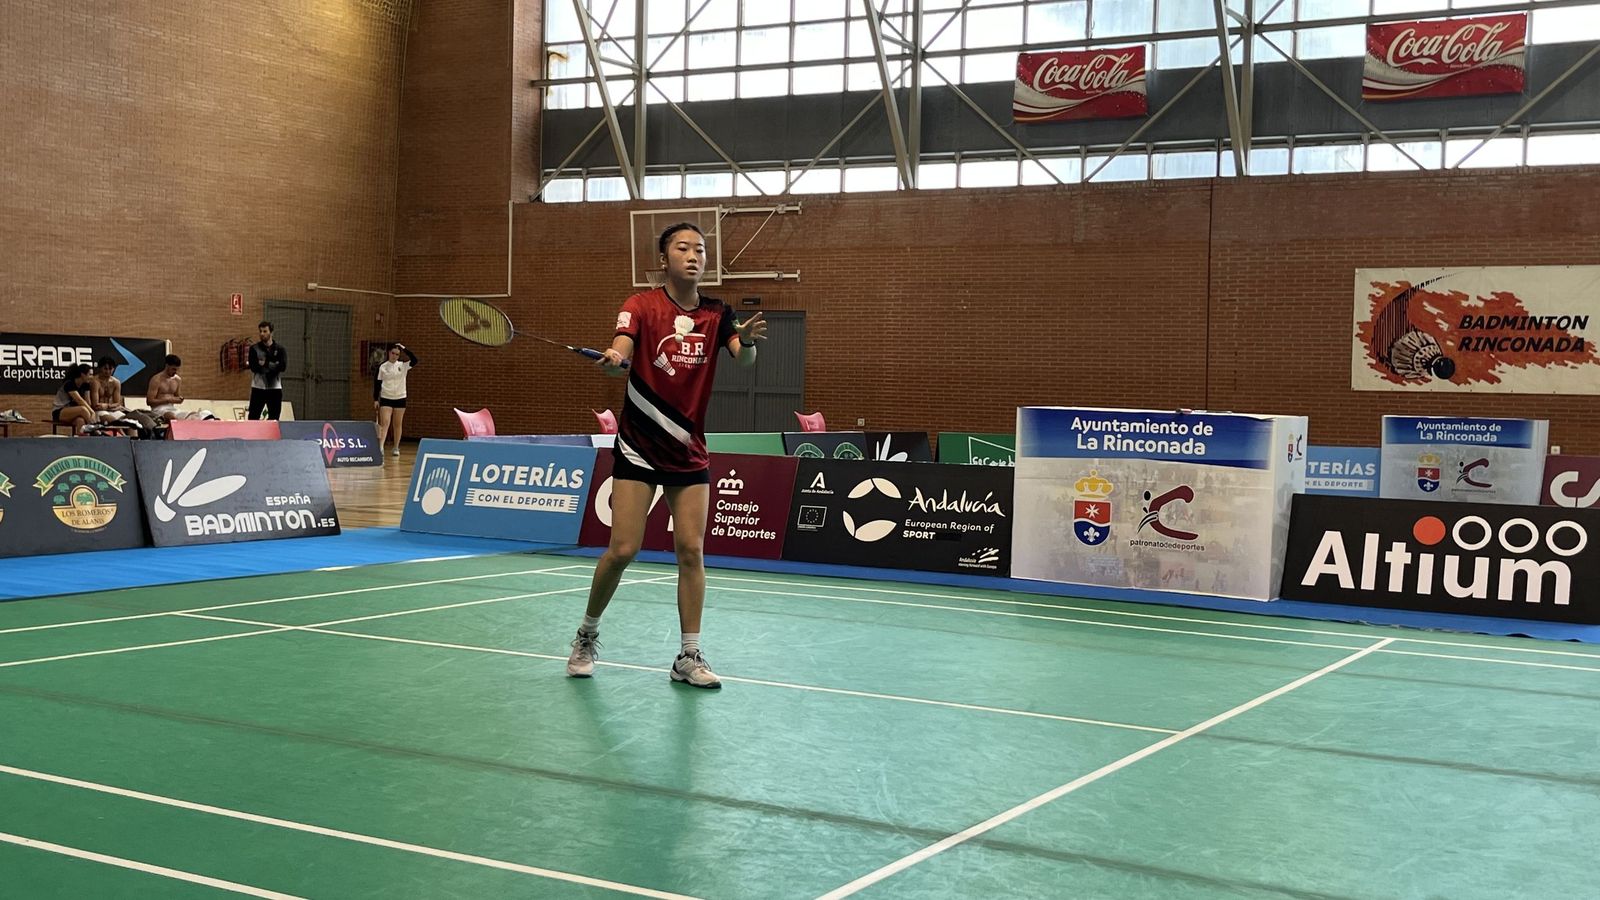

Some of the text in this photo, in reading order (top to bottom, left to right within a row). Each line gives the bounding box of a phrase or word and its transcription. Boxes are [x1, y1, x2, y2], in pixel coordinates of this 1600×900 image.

[1382, 21, 1512, 67] Coca-Cola
[1033, 52, 1135, 92] Coca-Cola
[1459, 314, 1589, 331] BADMINTON
[1458, 336, 1585, 353] RINCONADA
[3, 366, 66, 382] deportistas
[1070, 416, 1214, 436] Ayuntamiento de
[1416, 421, 1502, 432] Ayuntamiento de
[347, 438, 367, 449] S.L.
[1420, 430, 1497, 442] La Rinconada
[1076, 433, 1206, 456] La Rinconada
[469, 463, 585, 489] LOTERÍAS
[1324, 480, 1364, 488] DEPORTE
[265, 493, 311, 506] ESPAÑA
[478, 493, 566, 508] CON EL DEPORTE
[716, 500, 759, 514] Consejo
[907, 487, 1006, 517] Andalucía
[714, 512, 760, 526] Superior
[905, 519, 995, 534] European Region of
[711, 525, 776, 540] de Deportes
[902, 530, 936, 539] SPORT
[1301, 516, 1572, 605] Altium
